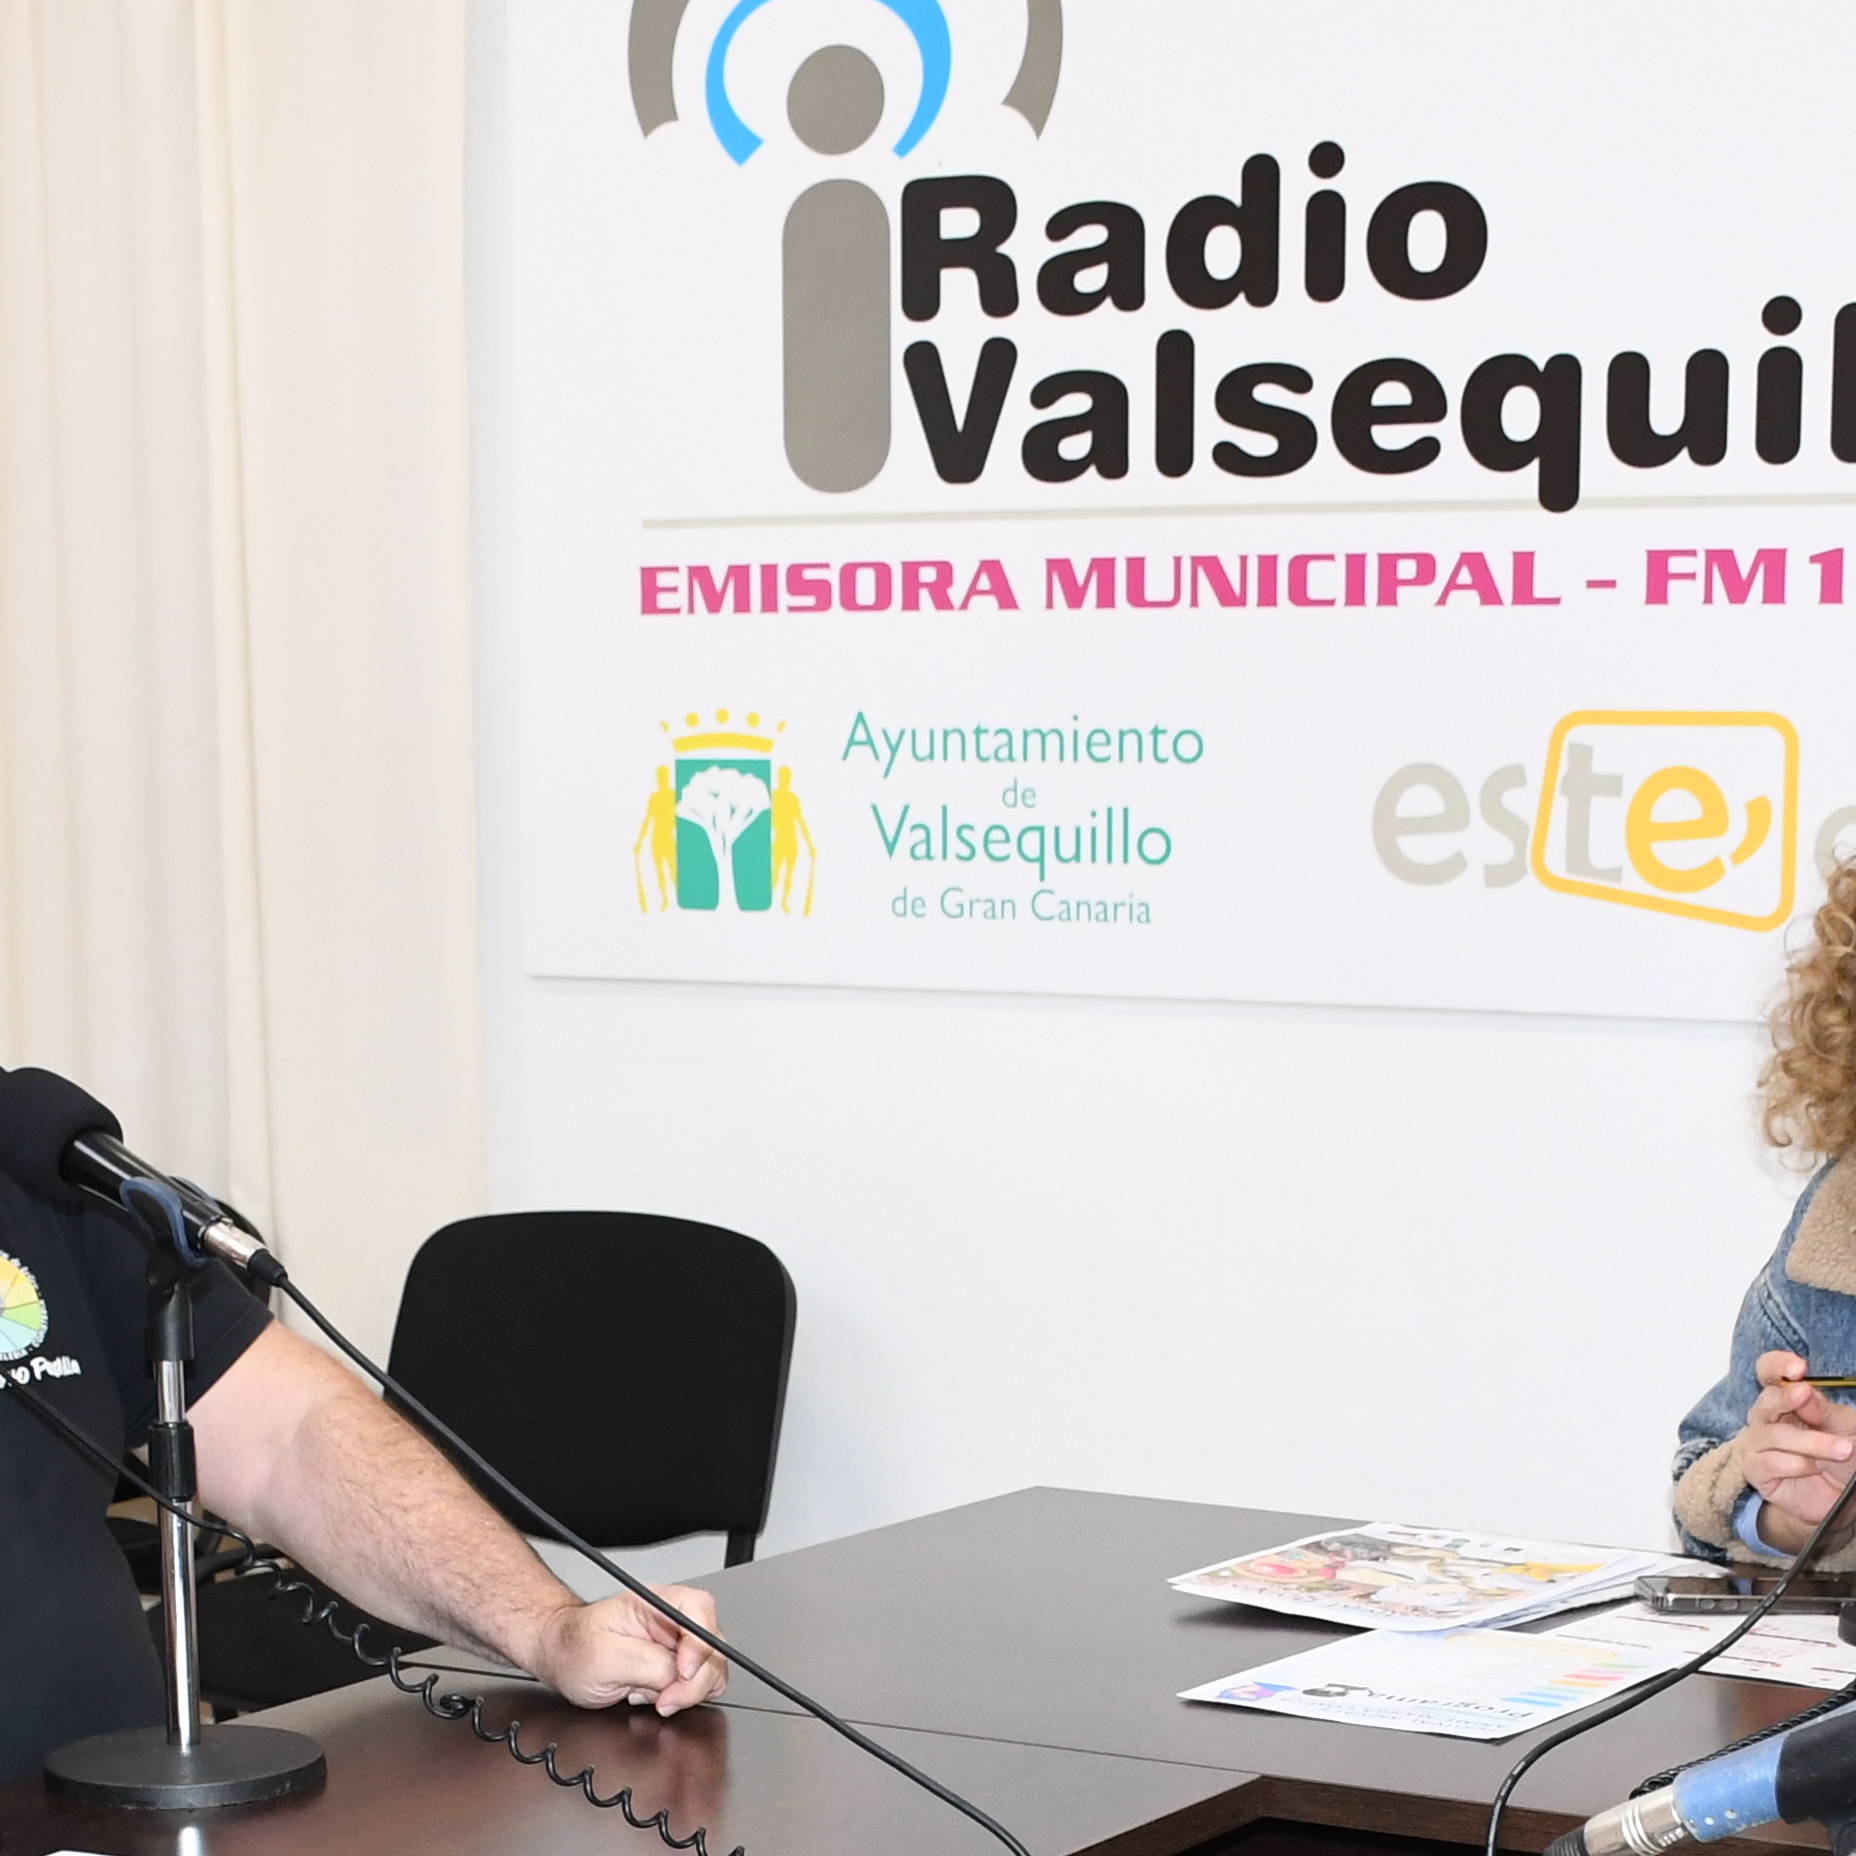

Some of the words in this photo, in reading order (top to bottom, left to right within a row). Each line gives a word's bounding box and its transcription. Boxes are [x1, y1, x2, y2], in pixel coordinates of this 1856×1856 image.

[901, 140, 1488, 322] Radio
[640, 559, 1020, 616] EMISORA
[1045, 550, 1563, 611] MUNICIPAL
[841, 710, 1206, 779] Ayuntamiento
[1001, 777, 1037, 809] de
[870, 802, 1173, 883] Valsequillo
[891, 886, 926, 918] de
[939, 886, 1017, 920] Gran
[1030, 889, 1152, 925] Canaria
